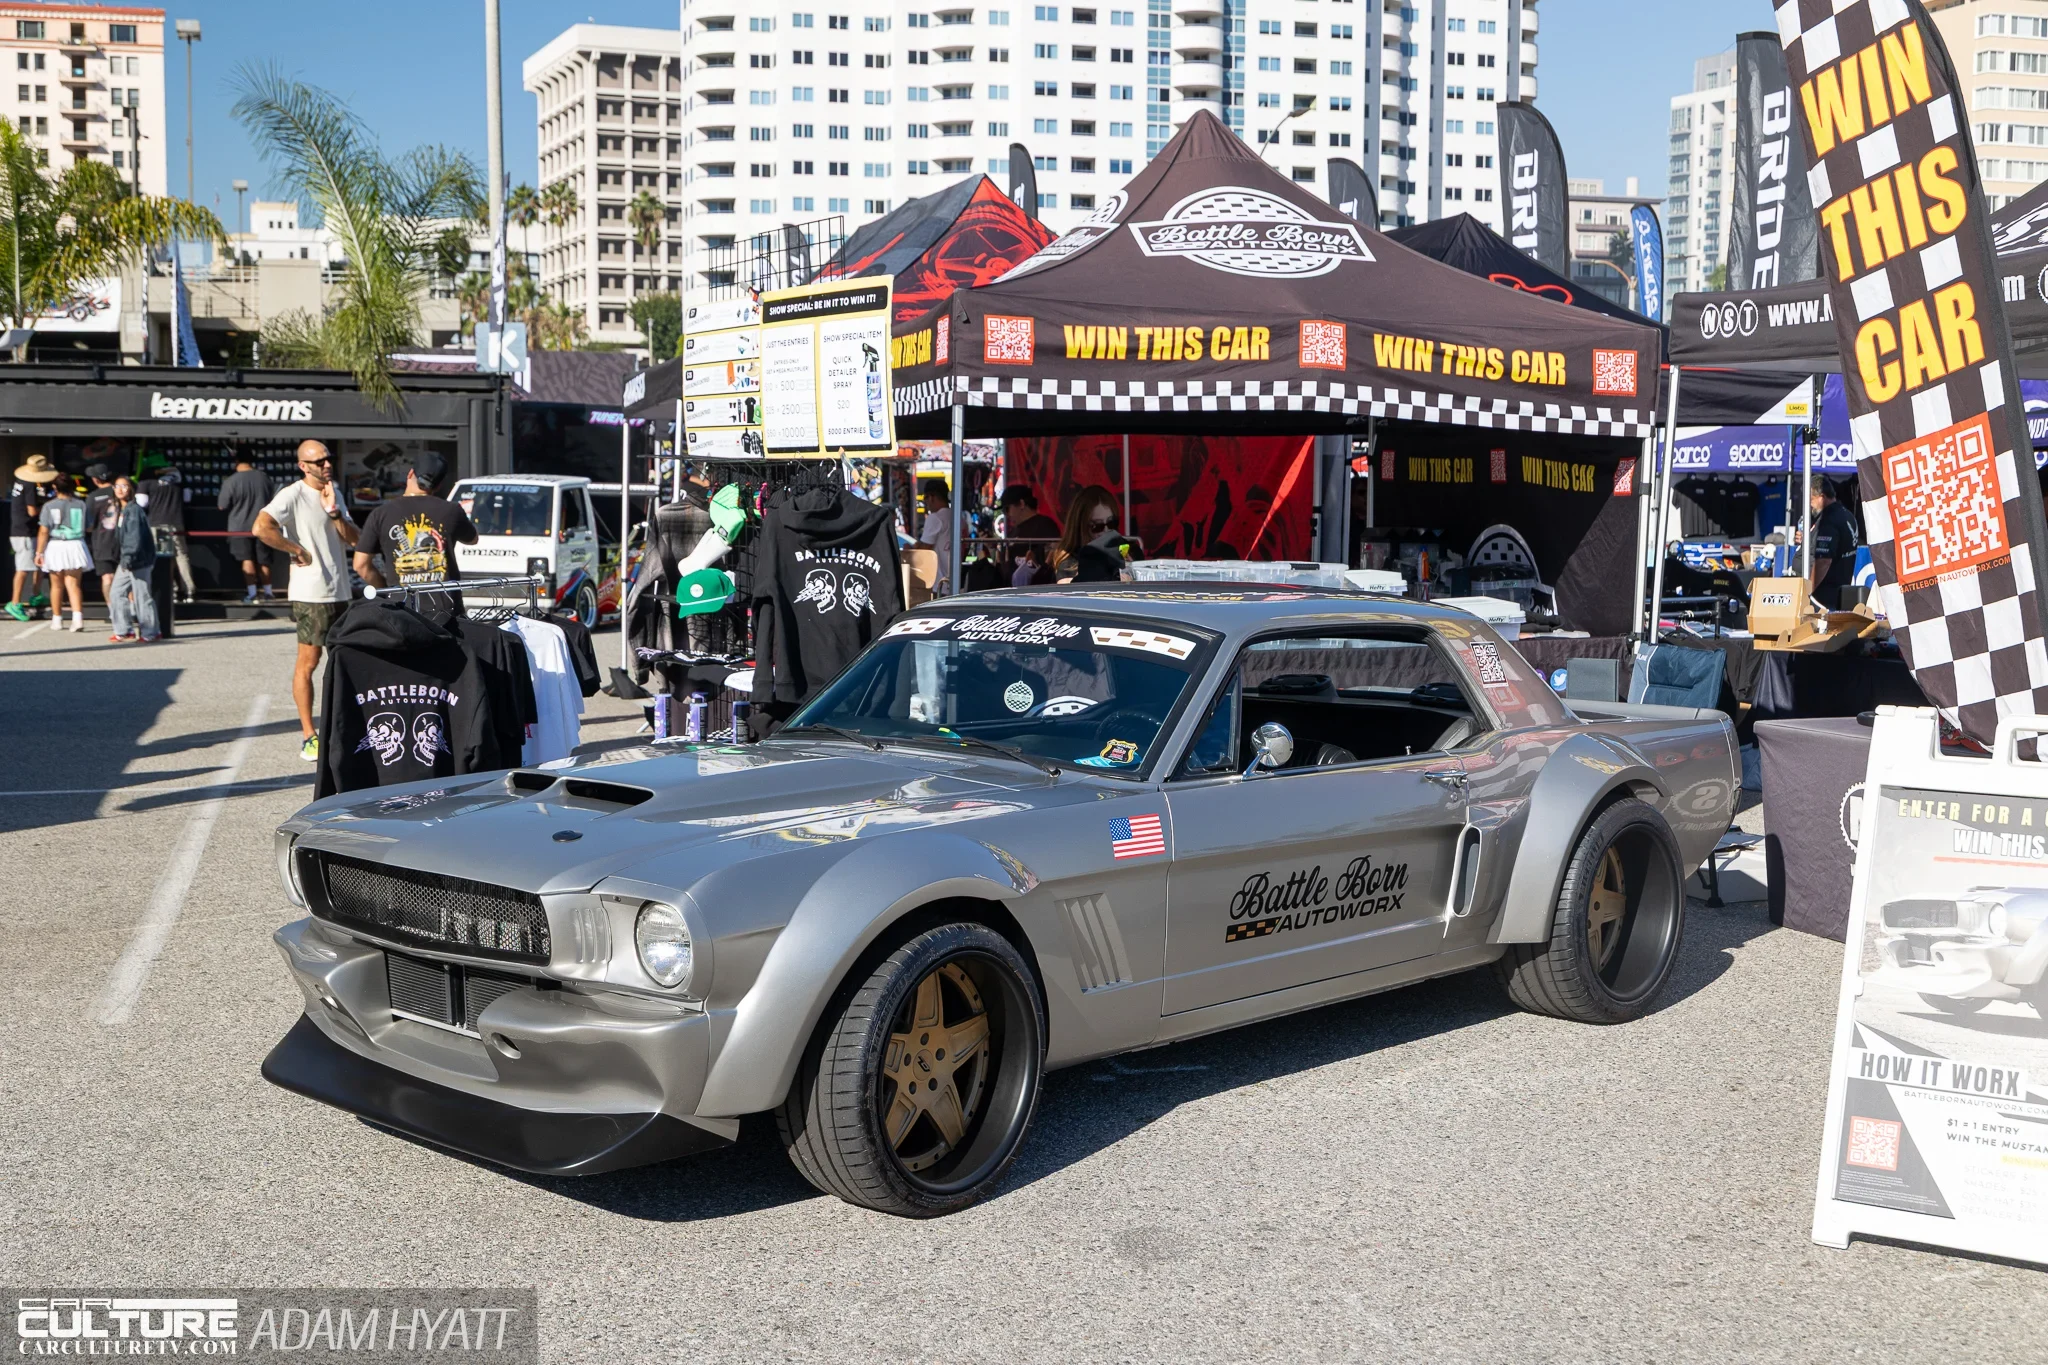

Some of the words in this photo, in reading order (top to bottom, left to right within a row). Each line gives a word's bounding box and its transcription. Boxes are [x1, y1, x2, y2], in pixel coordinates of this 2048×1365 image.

[1800, 20, 1933, 158] WIN
[1752, 85, 1791, 289] BRIDE
[1821, 145, 1968, 283] THIS
[1148, 223, 1258, 243] Battle
[1266, 224, 1353, 247] Born
[1209, 240, 1357, 255] AUTOWORX
[769, 304, 787, 315] SHOW
[787, 301, 814, 313] SPECIAL:
[814, 300, 823, 309] BE
[823, 298, 831, 308] IN
[832, 298, 839, 308] IT
[840, 297, 849, 306] TO
[850, 296, 865, 305] WIN
[866, 294, 877, 303] IT!
[777, 339, 787, 347] THE
[787, 337, 809, 346] ENTRIES
[823, 335, 841, 343] SHOW
[841, 332, 866, 341] SPECIAL
[866, 330, 882, 338] ITEM
[917, 328, 932, 364] CAR
[1063, 325, 1128, 360] WIN
[1134, 326, 1204, 361] THIS
[1210, 326, 1270, 361] CAR
[1853, 281, 1986, 404] CAR
[488, 329, 520, 369] K
[832, 356, 852, 365] QUICK
[1373, 333, 1434, 372] WIN
[1440, 342, 1504, 381] THIS
[1510, 350, 1566, 385] CAR
[828, 368, 857, 377] DETAILER
[781, 380, 795, 391] 500
[833, 381, 852, 389] SPRAY
[781, 403, 800, 415] 2500
[837, 400, 850, 409] $20
[1729, 444, 1782, 468] sparco
[1409, 457, 1428, 482] WIN
[1429, 458, 1451, 482] THIS
[1453, 458, 1473, 483] CAR
[1522, 456, 1544, 484] WIN
[1545, 458, 1569, 490] THIS
[1571, 463, 1595, 492] CAR
[472, 485, 502, 493] TOYO
[504, 485, 540, 494] TIRES
[795, 548, 881, 574] BATTLEBORN
[816, 558, 864, 569] AUTOWORX
[1900, 556, 2011, 594] BATTLEBORNAUTOWORX.COM
[951, 614, 1021, 633] Battle
[1019, 617, 1082, 638] Born
[957, 631, 1055, 645] AUTOWORX
[356, 684, 459, 707] BATTLEBORN
[380, 698, 439, 706] AUTOWORX
[1898, 799, 1961, 821] ENTER
[1971, 803, 2010, 825] FOR
[2021, 807, 2033, 827] A
[1954, 829, 1994, 855] WIN
[2000, 833, 2046, 860] THIS
[1230, 871, 1329, 920] Battle
[1335, 855, 1409, 900] Born
[1277, 893, 1405, 933] AUTOWORX
[1860, 1052, 1913, 1082] HOW
[1921, 1060, 1942, 1086] IT
[1952, 1063, 2020, 1097] WORX
[1904, 1090, 2048, 1116] BATTLEBORNAUTOWORX.COM
[1947, 1118, 1958, 1128] $1
[1982, 1124, 2020, 1136] ENTRY
[1947, 1132, 1970, 1143] WIN
[1975, 1136, 1997, 1147] THE
